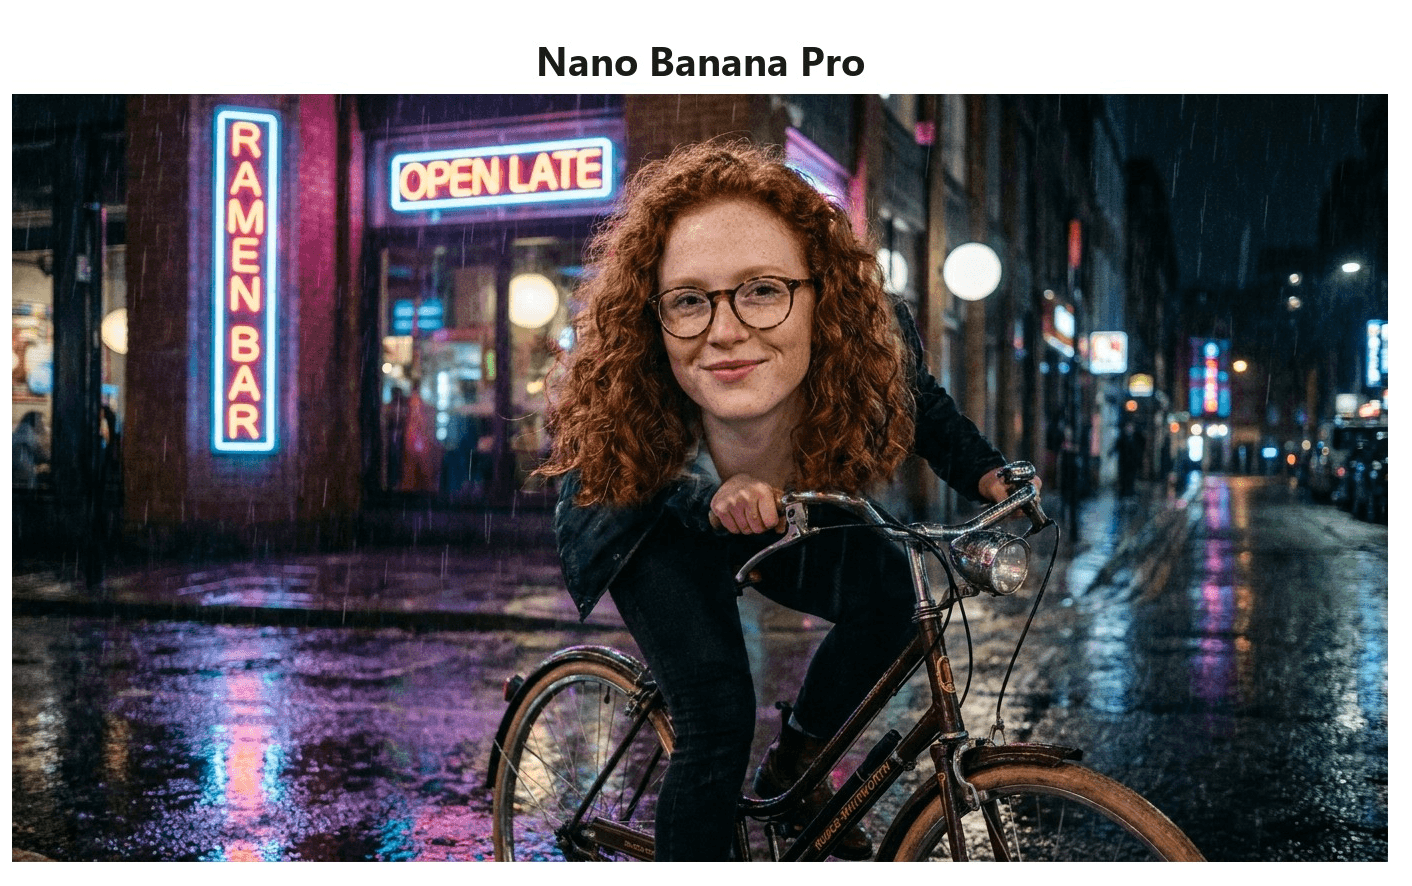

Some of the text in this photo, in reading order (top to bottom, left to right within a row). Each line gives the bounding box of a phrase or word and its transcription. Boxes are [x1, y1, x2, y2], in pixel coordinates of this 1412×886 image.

[399, 148, 602, 201] OPEN LATE
[228, 121, 265, 439] RAMEN BAR
